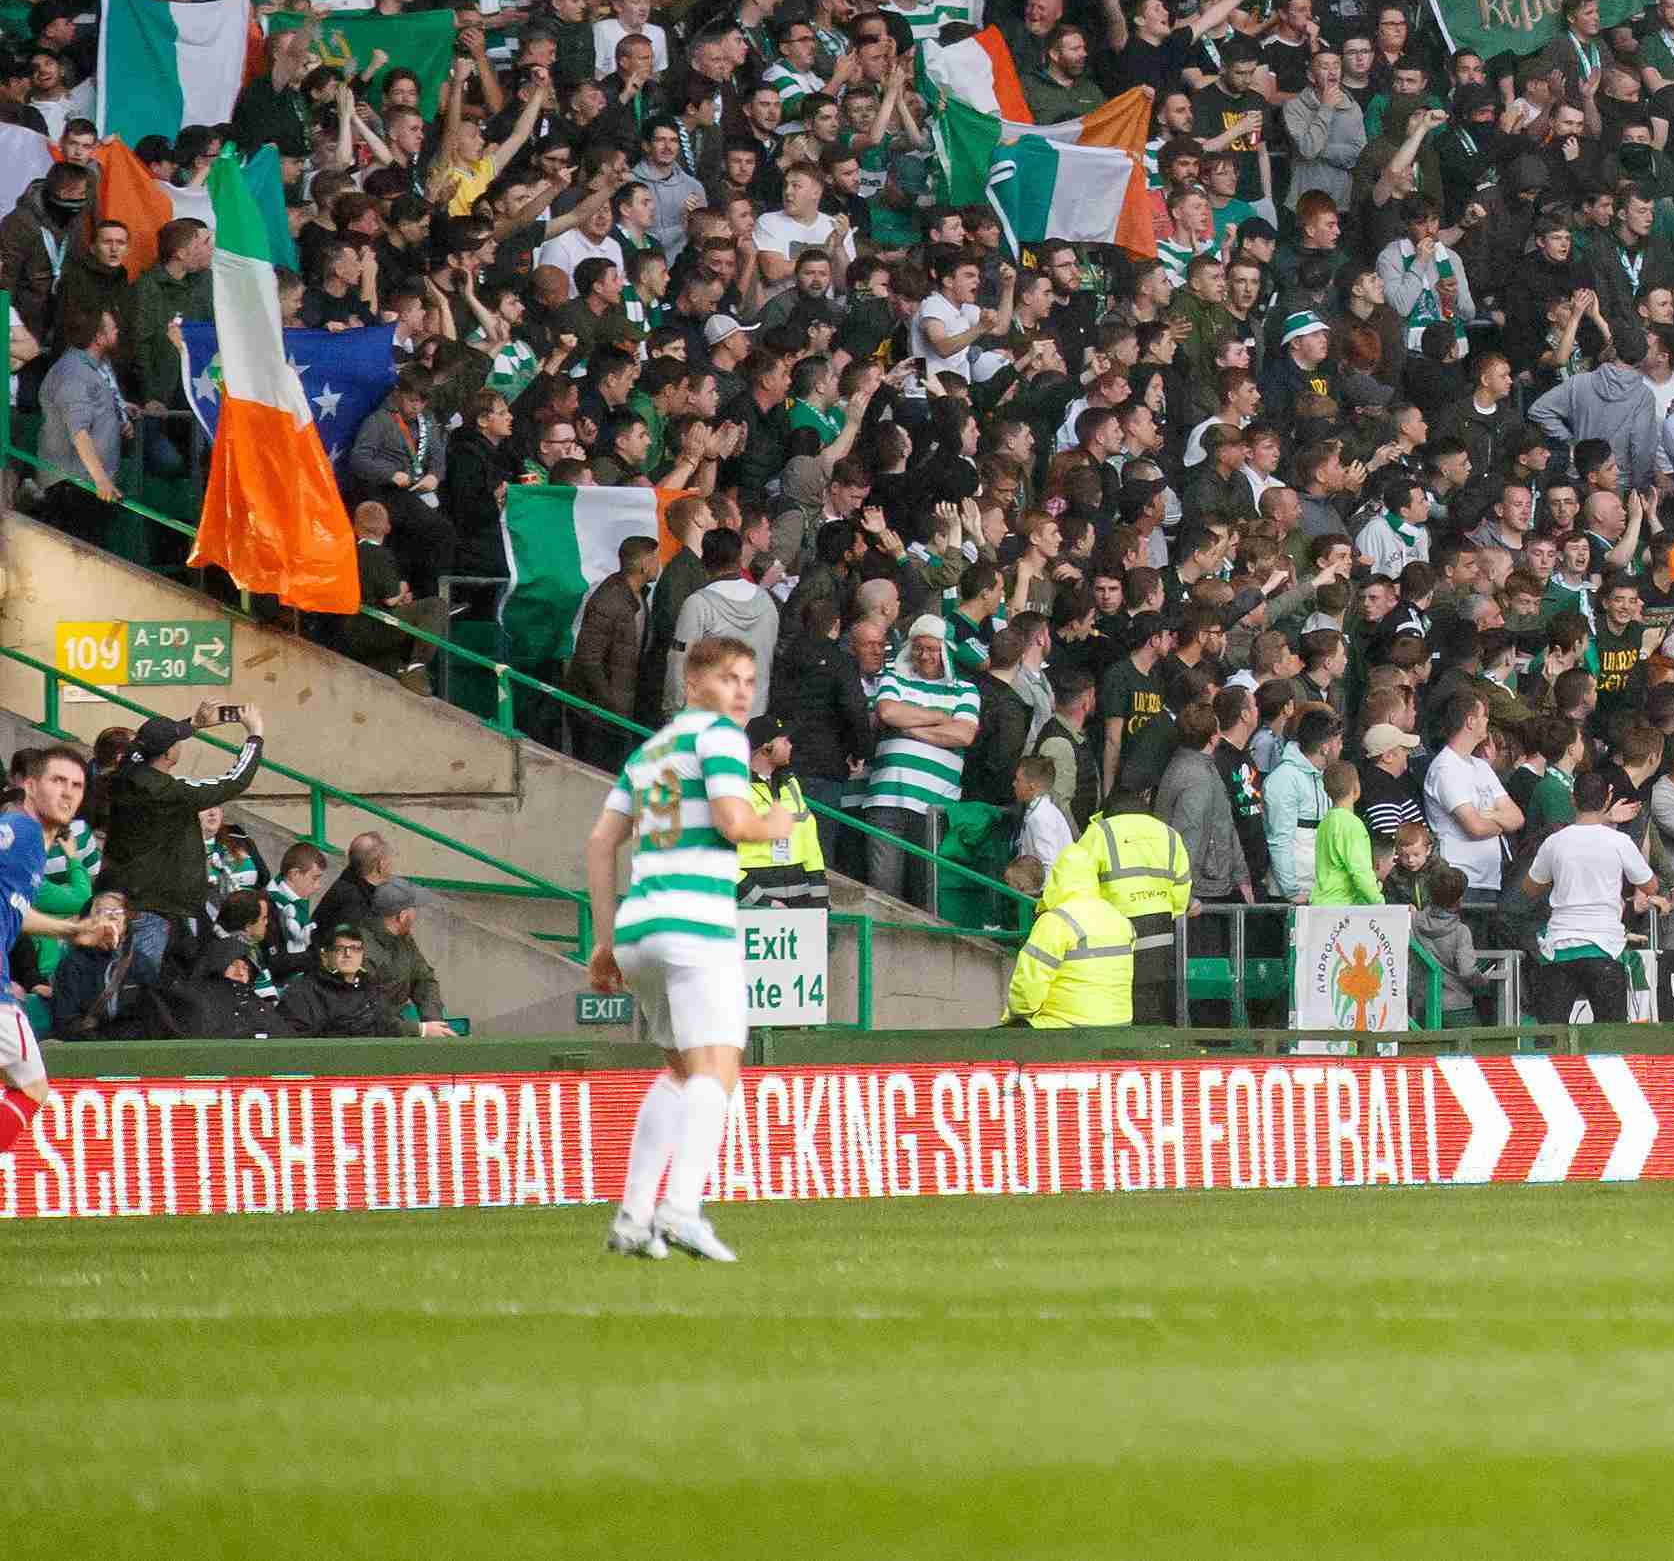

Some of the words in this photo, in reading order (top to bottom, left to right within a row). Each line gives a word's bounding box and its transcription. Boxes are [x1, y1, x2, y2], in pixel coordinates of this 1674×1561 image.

[64, 635, 121, 670] 109
[744, 926, 798, 961] Exit
[793, 974, 825, 1008] 14
[580, 998, 626, 1020] EXIT
[34, 1084, 314, 1217] SCOTTISH
[332, 1080, 607, 1211] FOOTBALL
[712, 1071, 917, 1202] ACKING
[934, 1068, 1184, 1194] SCOTTISH
[1201, 1063, 1460, 1191] FOOTBALL
